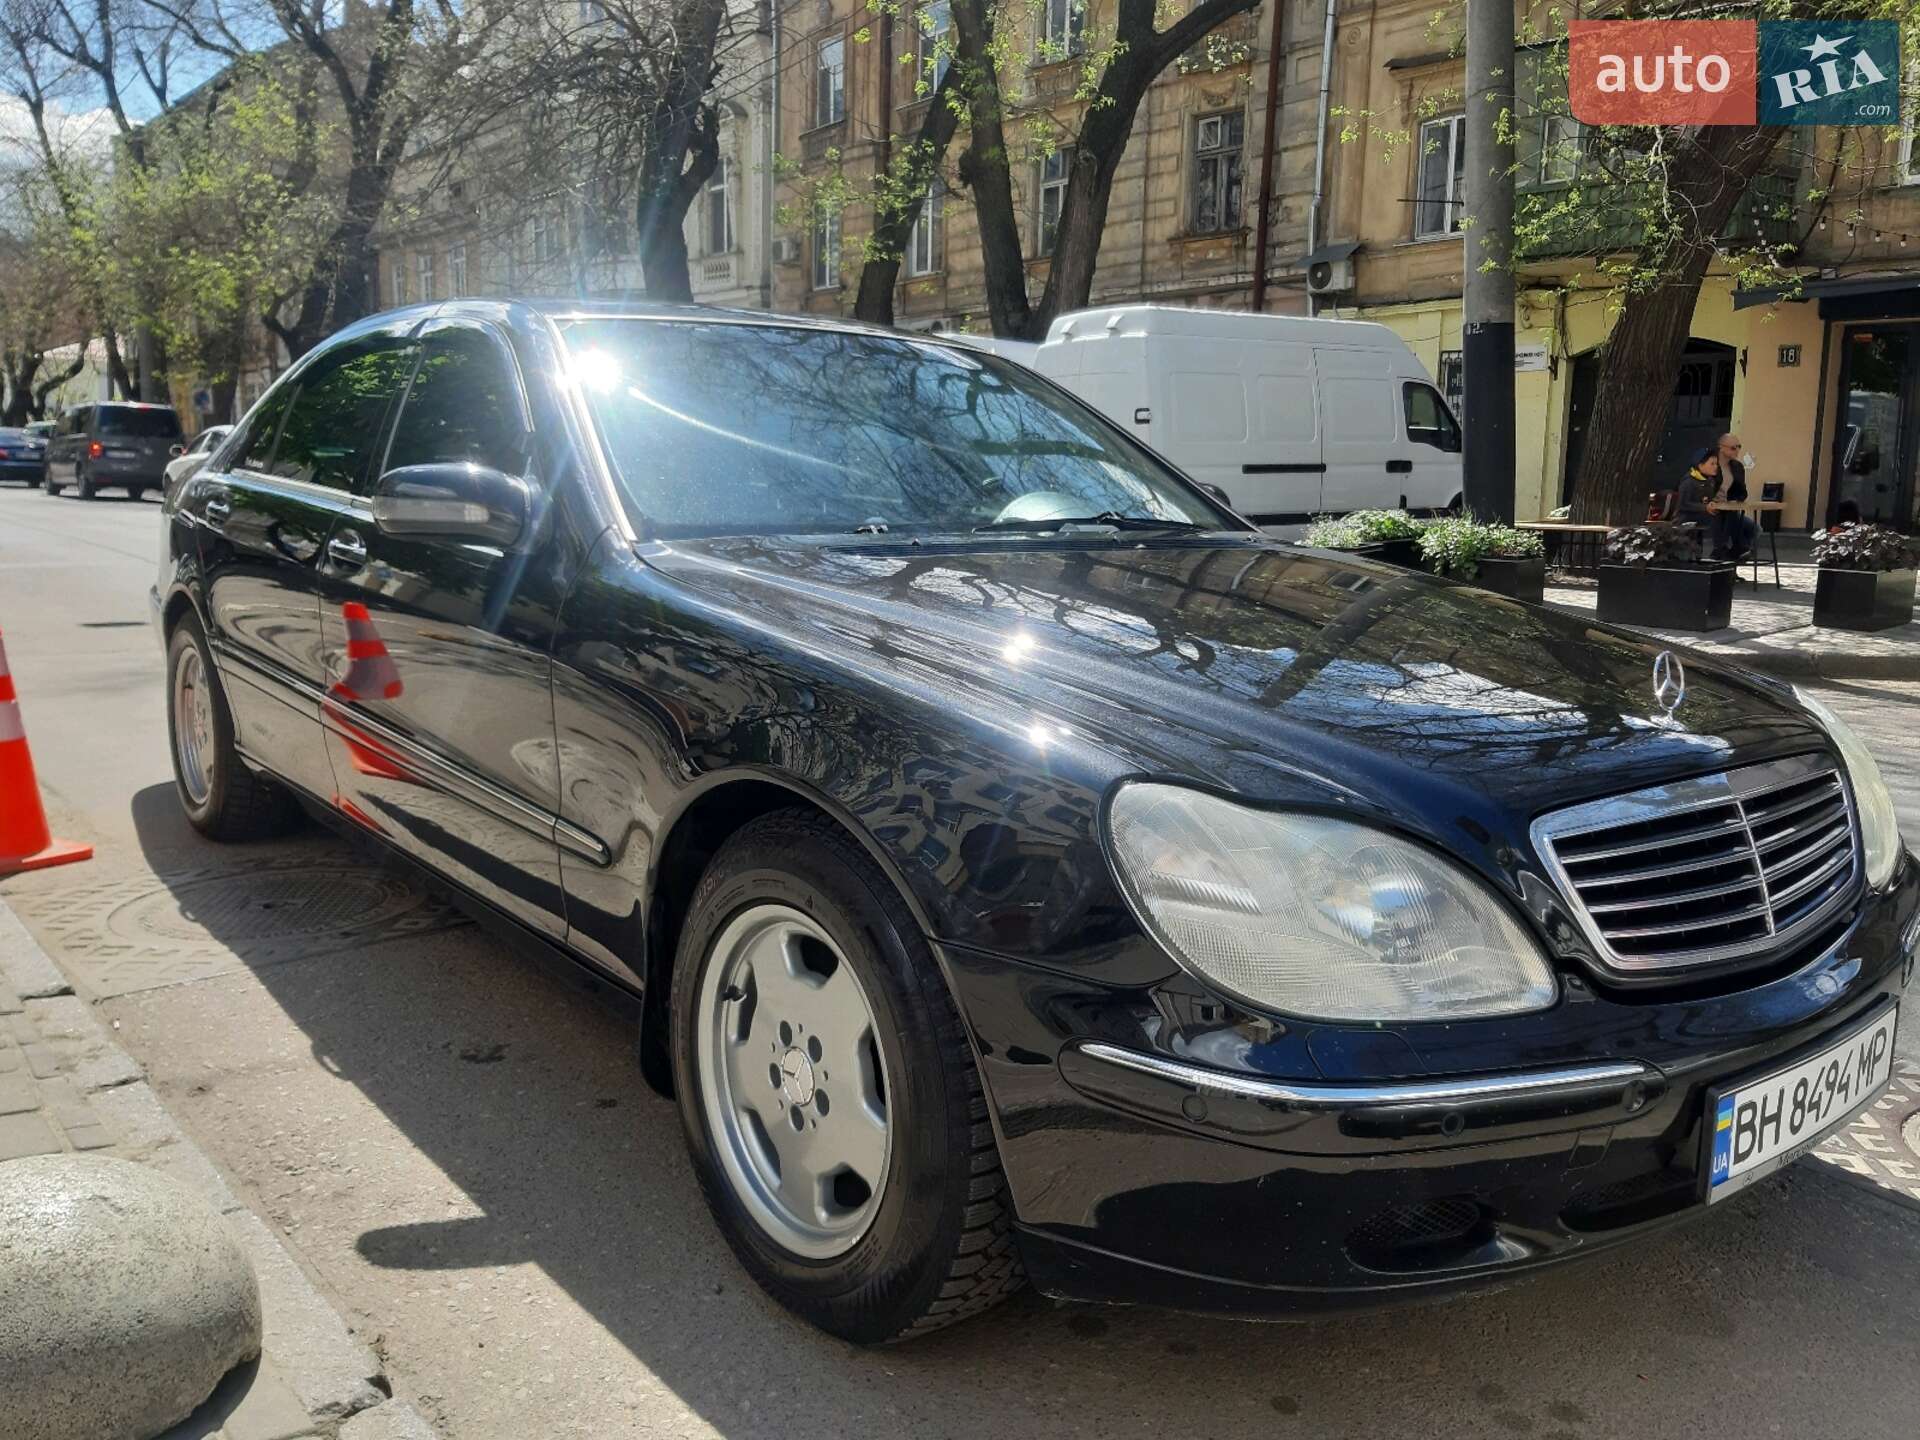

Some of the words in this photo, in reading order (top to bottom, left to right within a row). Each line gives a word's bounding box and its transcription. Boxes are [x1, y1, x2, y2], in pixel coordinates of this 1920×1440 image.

[1783, 348, 1796, 363] 18
[1732, 1085, 1785, 1166] BH
[1788, 1049, 1855, 1136] 8494
[1854, 1026, 1888, 1097] MP
[1712, 1151, 1728, 1174] UA
